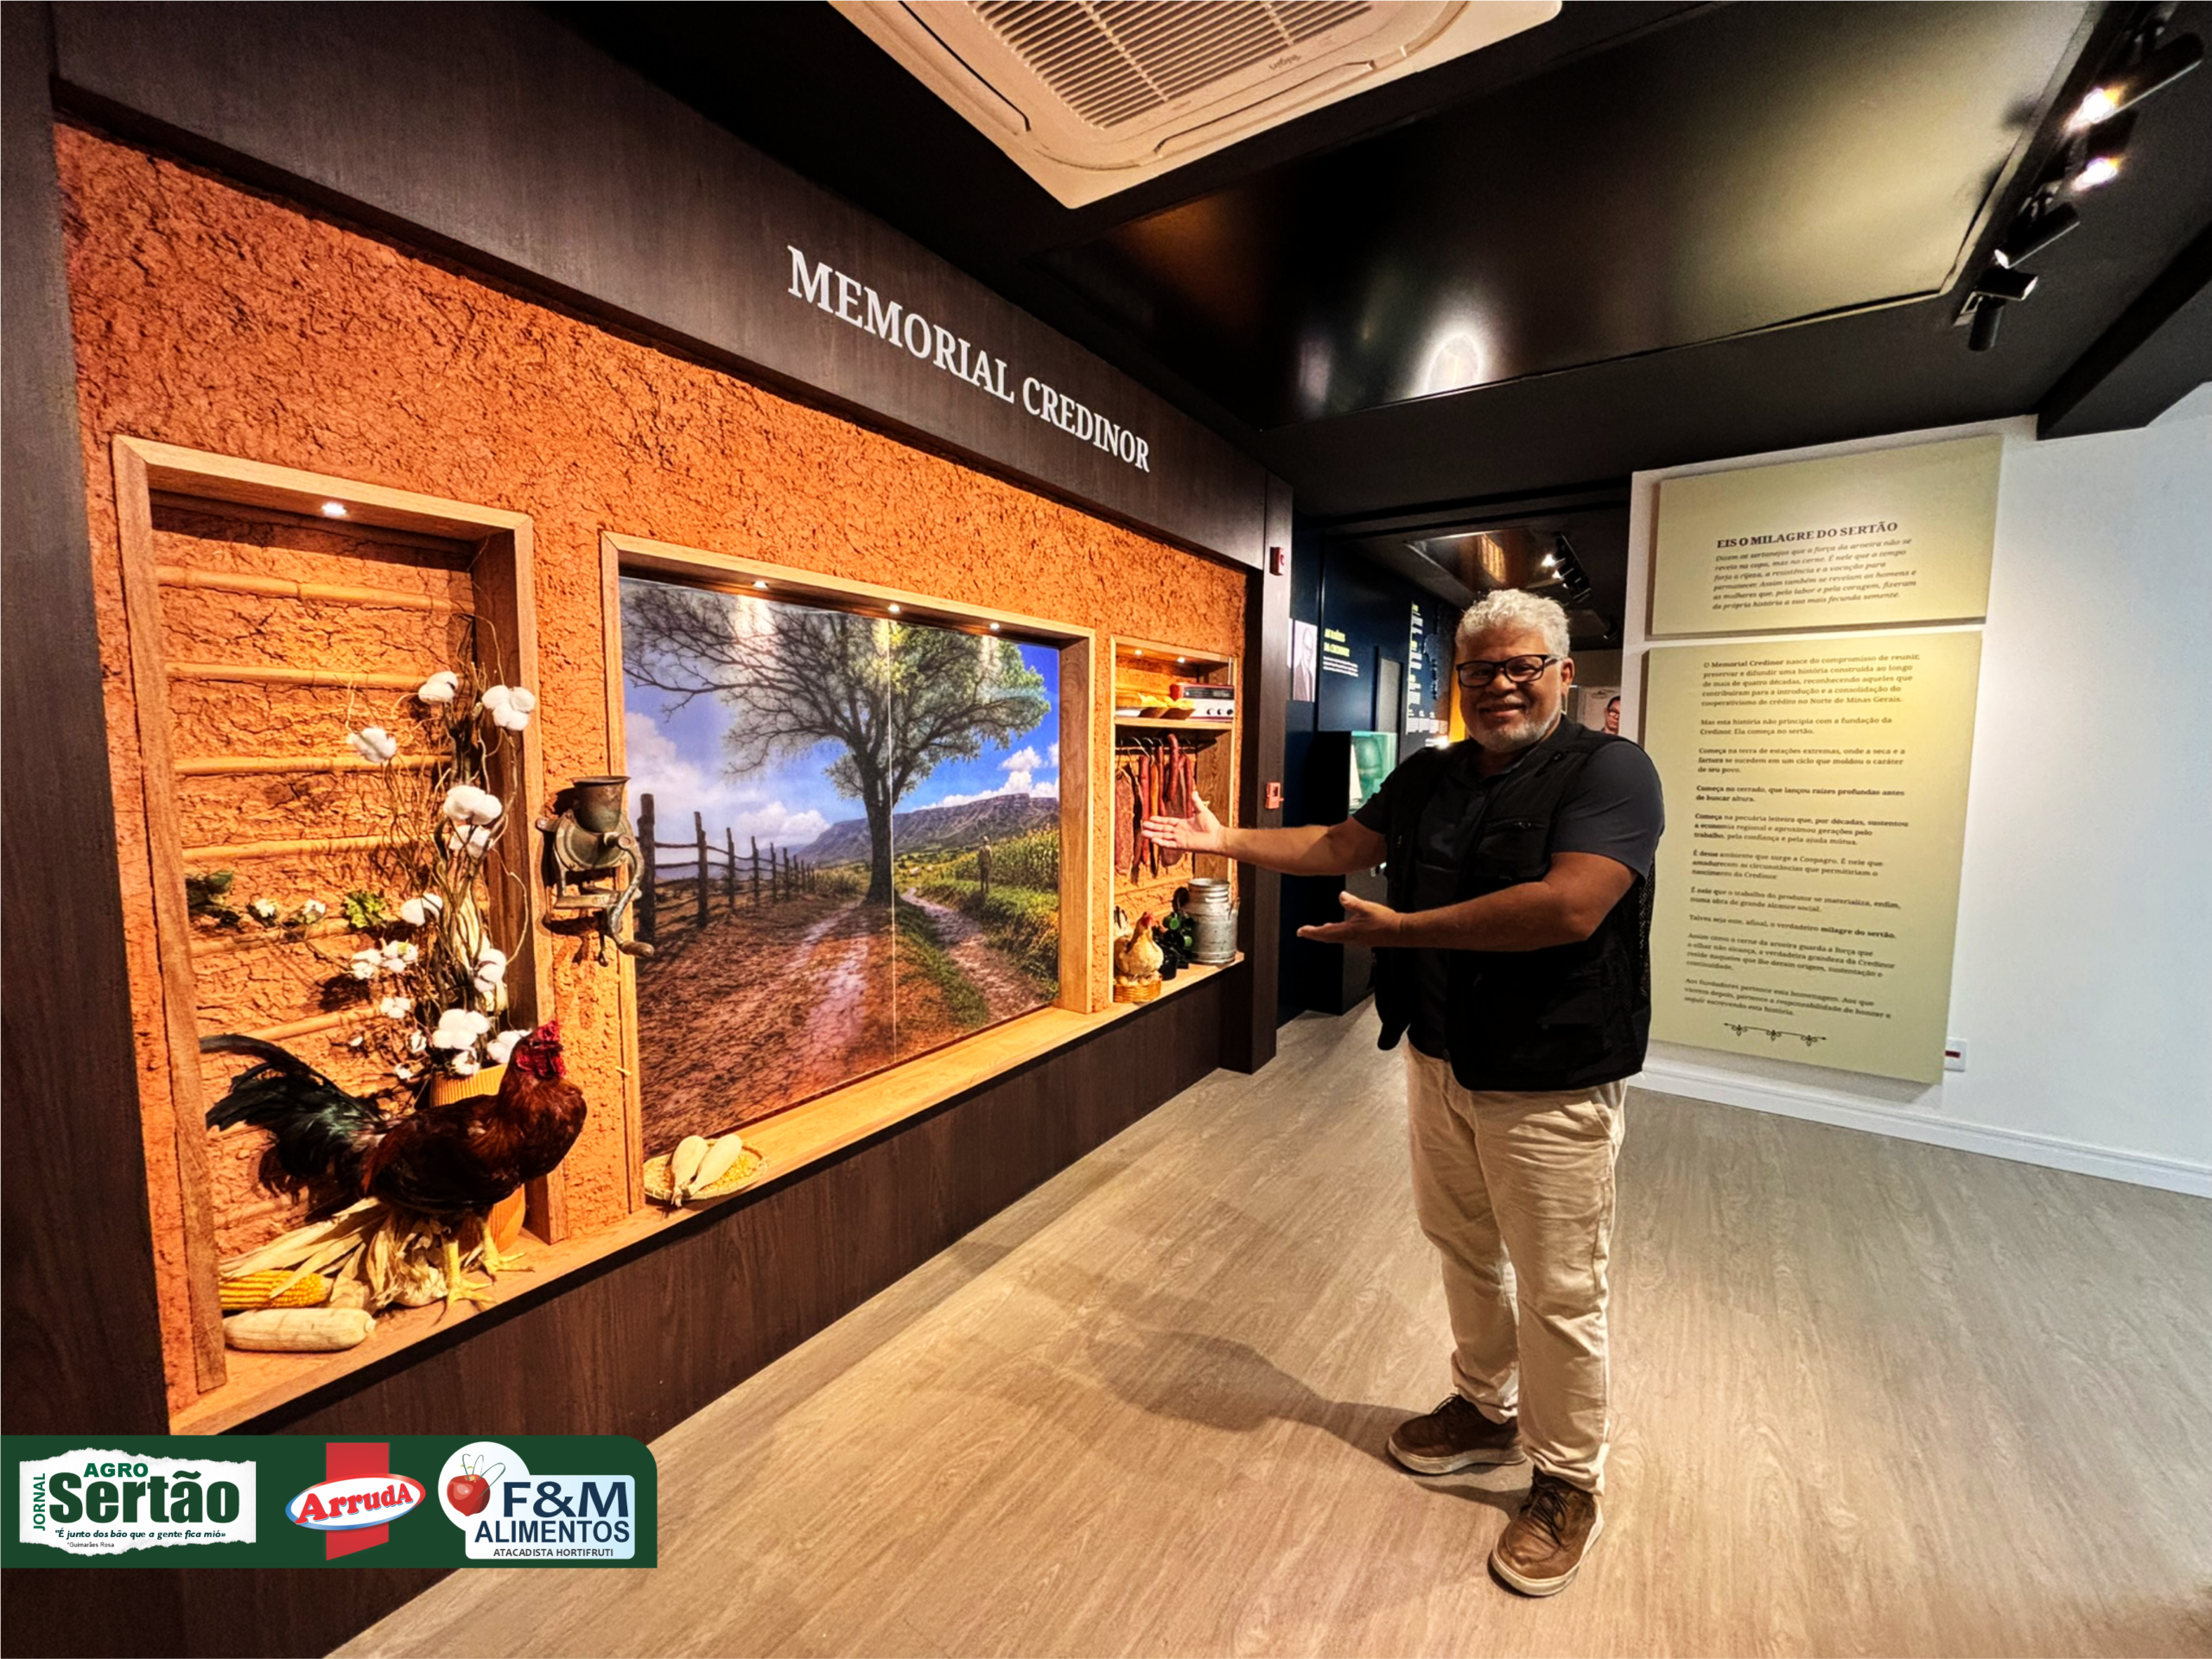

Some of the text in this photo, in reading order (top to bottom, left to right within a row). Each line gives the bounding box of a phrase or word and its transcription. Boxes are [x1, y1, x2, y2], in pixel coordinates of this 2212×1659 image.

[787, 245, 1150, 473] MEMORIAL CREDINOR
[1717, 521, 1898, 548] EIS O MILAGRE DO SERTÃO
[1828, 594, 1861, 603] fecunda
